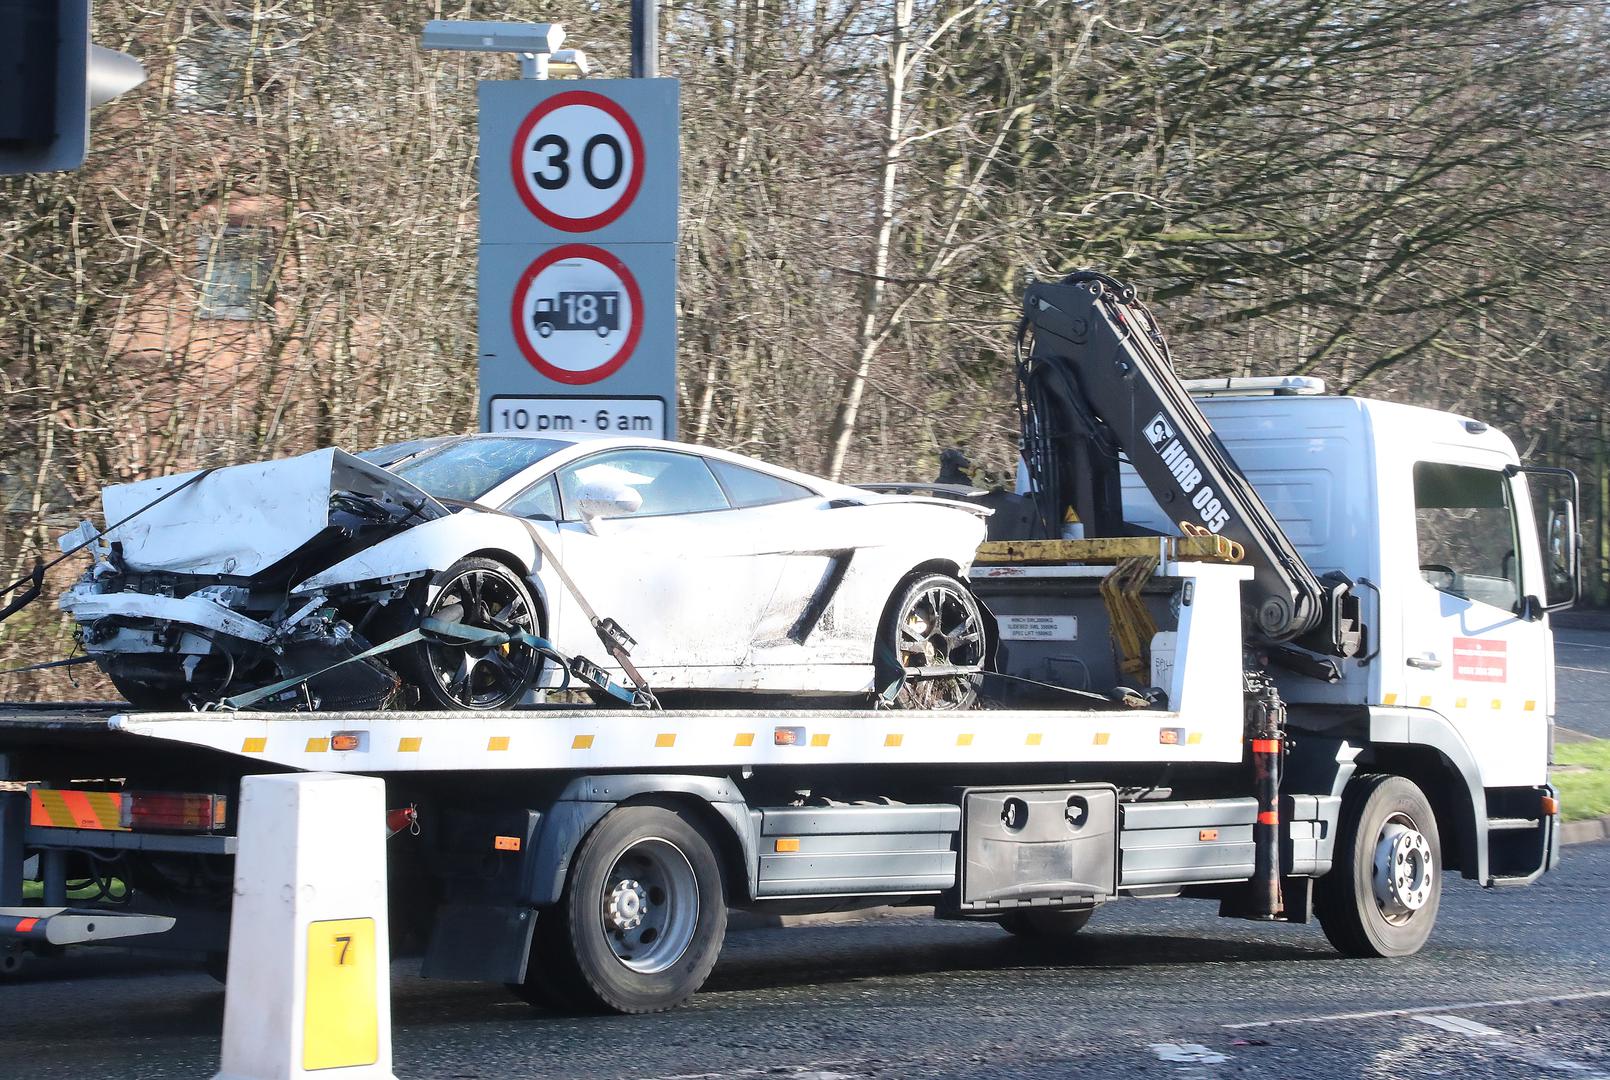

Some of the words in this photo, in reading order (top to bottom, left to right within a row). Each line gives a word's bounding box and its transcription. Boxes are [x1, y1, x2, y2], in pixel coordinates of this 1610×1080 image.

[532, 133, 624, 190] 30
[502, 409, 530, 430] 10
[537, 414, 573, 432] pm
[595, 409, 610, 431] 6
[617, 415, 653, 431] am
[1160, 438, 1203, 493] HIAB
[1192, 485, 1231, 534] 095
[335, 936, 351, 965] 7
